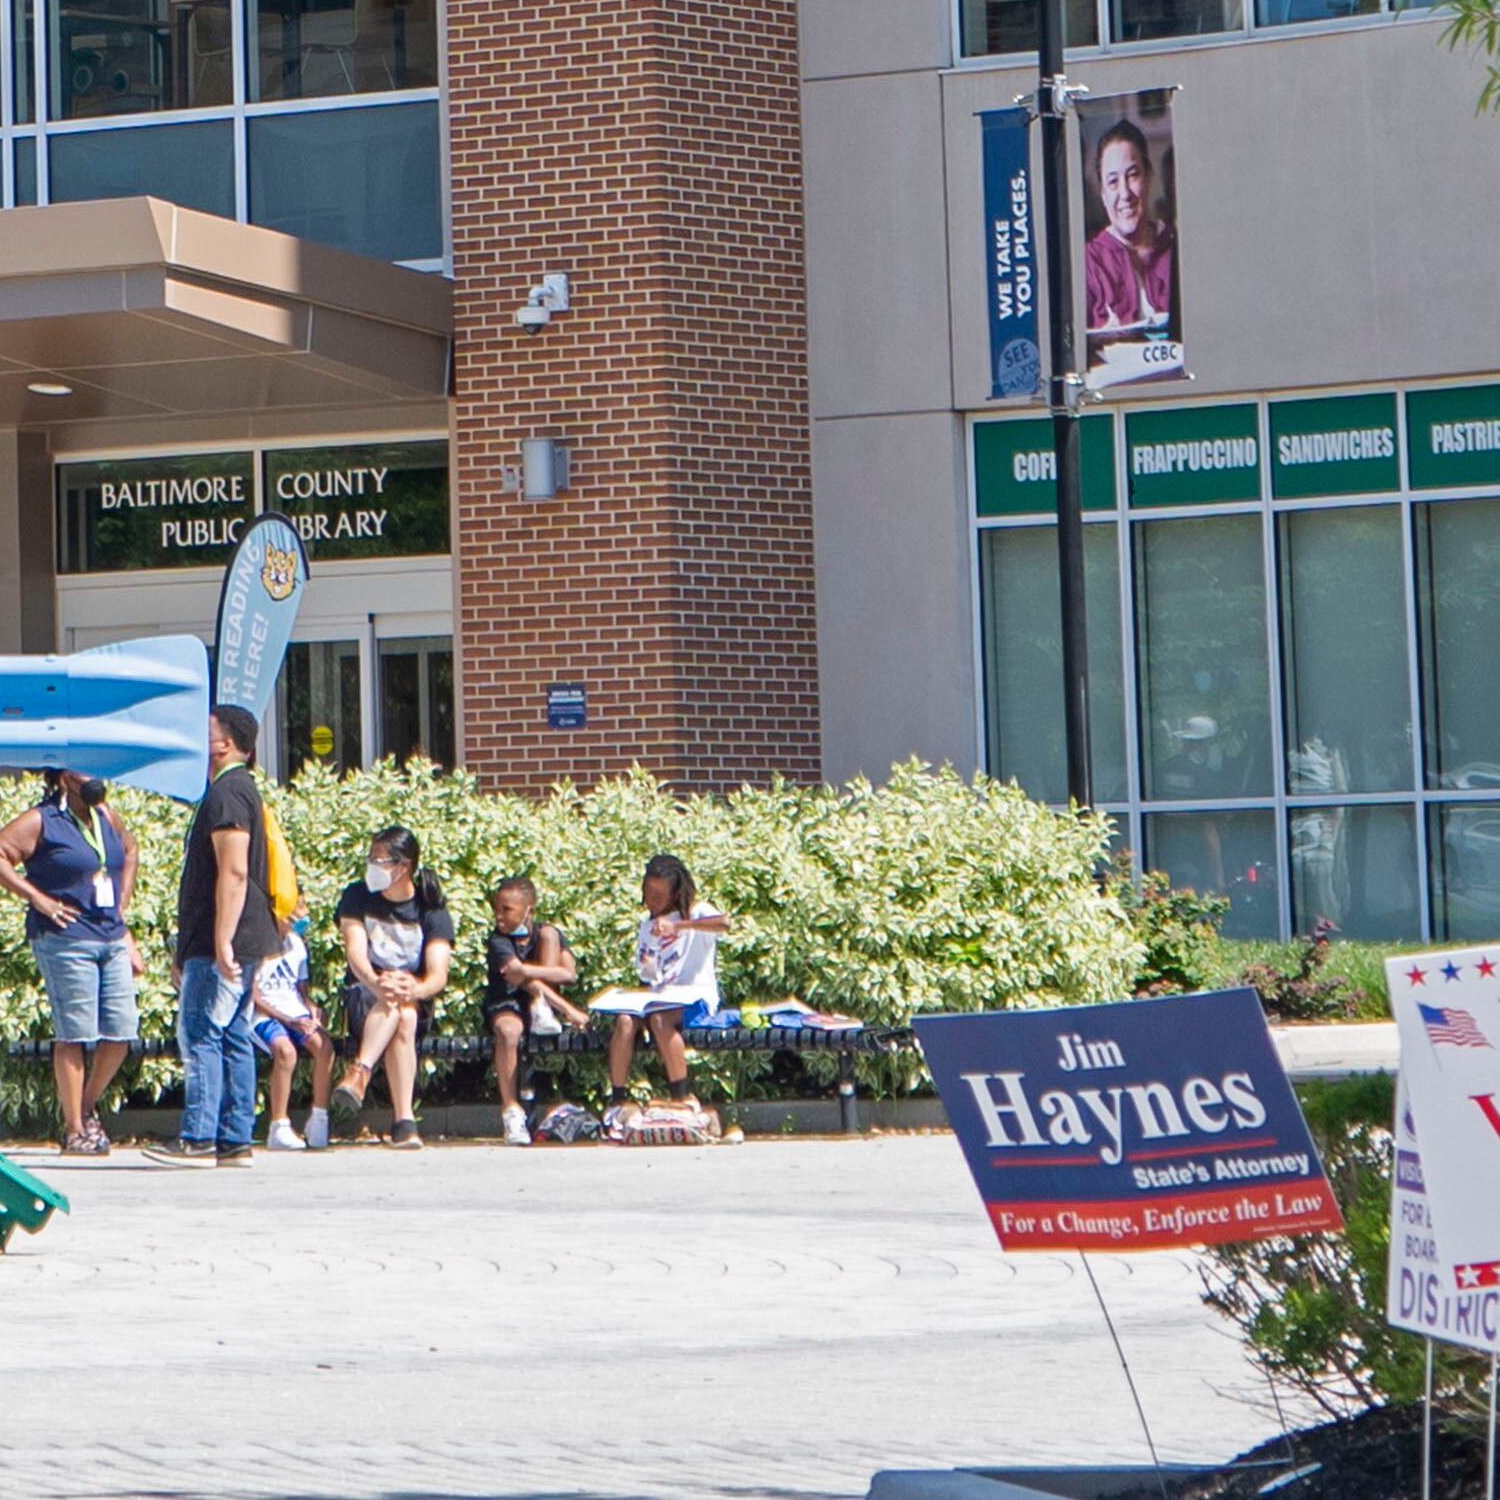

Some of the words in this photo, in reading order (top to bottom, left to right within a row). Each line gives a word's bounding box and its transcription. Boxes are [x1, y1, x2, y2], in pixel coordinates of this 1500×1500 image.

[1011, 169, 1030, 259] PLACES.
[995, 219, 1011, 277] TAKE
[998, 279, 1014, 320] WE
[1015, 264, 1033, 318] YOU
[1004, 341, 1030, 368] SEE
[1143, 344, 1178, 363] CCBC
[1133, 437, 1258, 476] FRAPPUCCINO
[1278, 428, 1394, 466] SANDWICHES
[101, 476, 245, 509] BALTIMORE
[276, 467, 388, 499] COUNTY
[161, 518, 245, 548] PUBLIC
[292, 510, 387, 541] IBRARY
[224, 538, 261, 668] READING
[242, 612, 269, 701] HERE!
[1056, 1033, 1126, 1071] Jim
[960, 1072, 1266, 1165] Haynes
[1132, 1161, 1211, 1190] State's
[1215, 1153, 1310, 1182] Attorney
[1000, 1211, 1036, 1235] For
[1041, 1217, 1054, 1234] a
[1057, 1211, 1139, 1239] Change,
[1144, 1204, 1231, 1235] Enforce
[1235, 1198, 1270, 1221] the
[1274, 1193, 1323, 1217] Law
[1402, 1200, 1423, 1225] FOR
